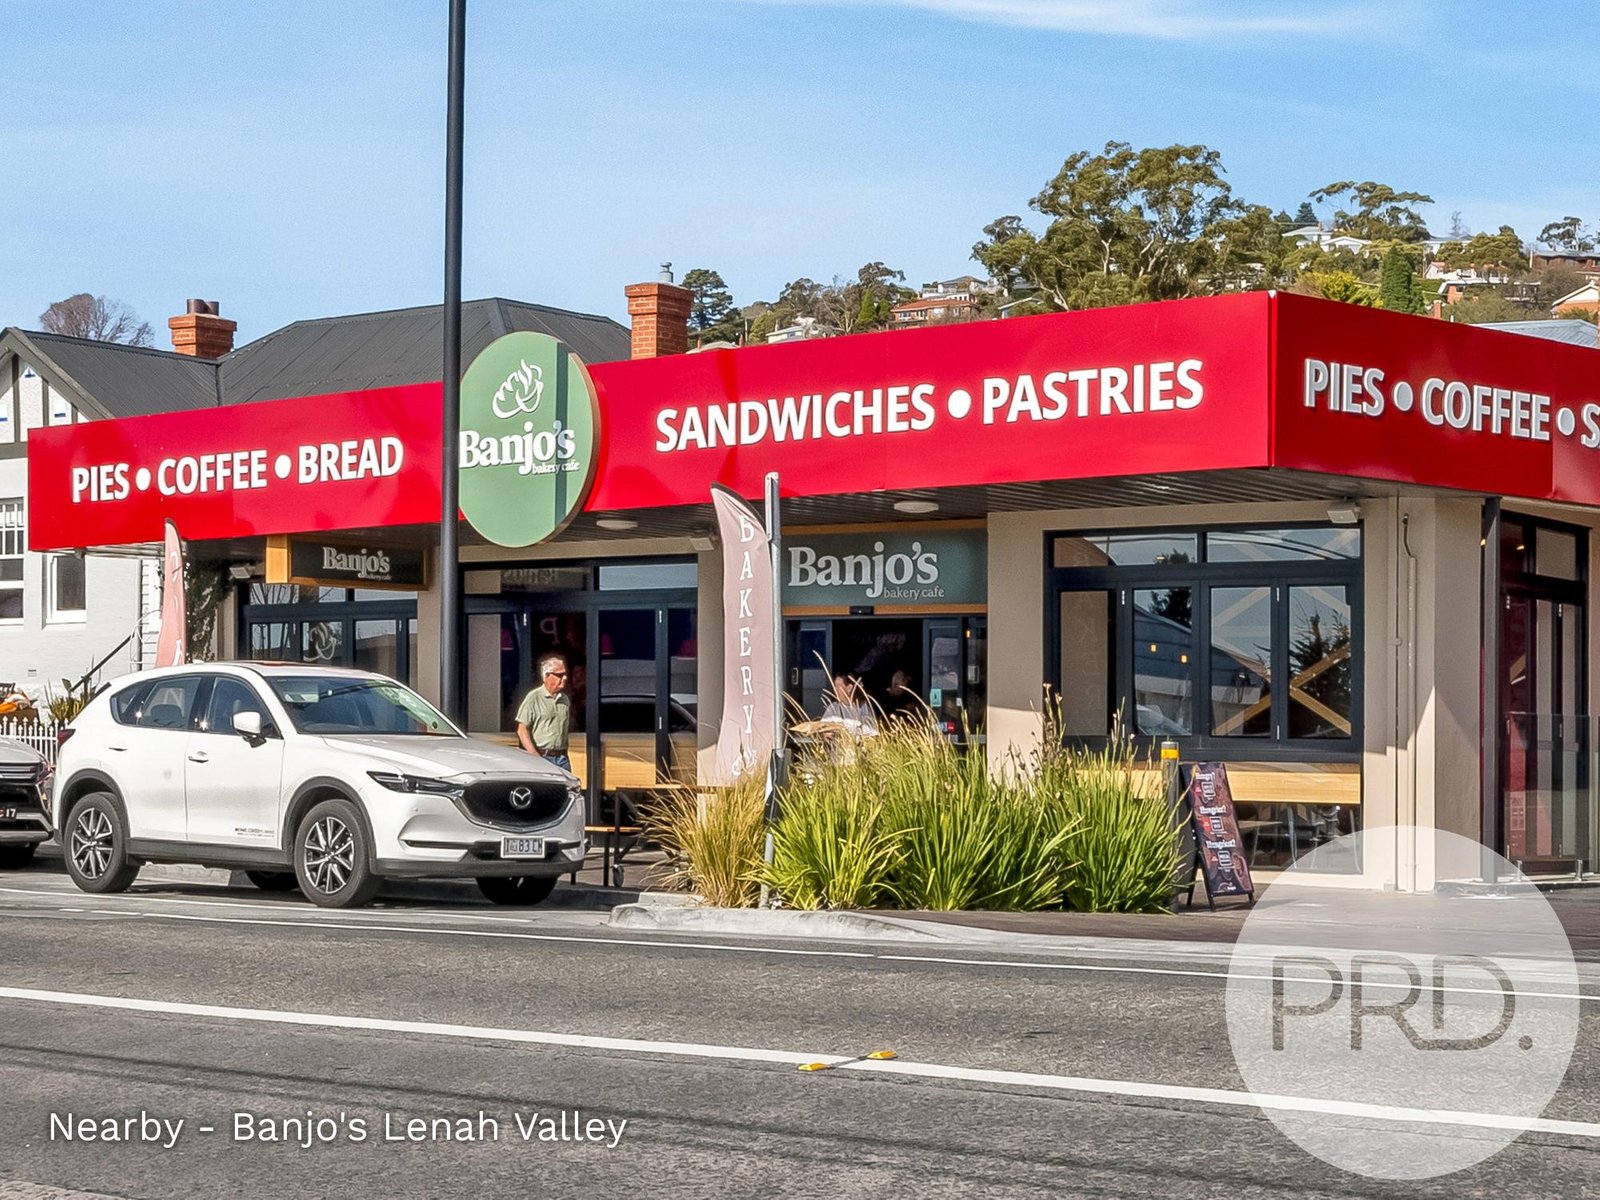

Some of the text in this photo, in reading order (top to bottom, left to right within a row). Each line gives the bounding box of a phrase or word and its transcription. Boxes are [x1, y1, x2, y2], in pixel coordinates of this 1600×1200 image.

[655, 359, 1204, 453] SANDWICHES PASTRIES
[1304, 358, 1385, 417] PIES
[1422, 377, 1551, 441] COFFEE
[72, 436, 404, 504] PIES COFFEE BREAD
[459, 420, 576, 475] Banjo's
[322, 546, 391, 579] Banjo's
[787, 541, 939, 598] Banjo's
[883, 585, 945, 600] bakery cafe
[738, 514, 755, 734] BAKERY
